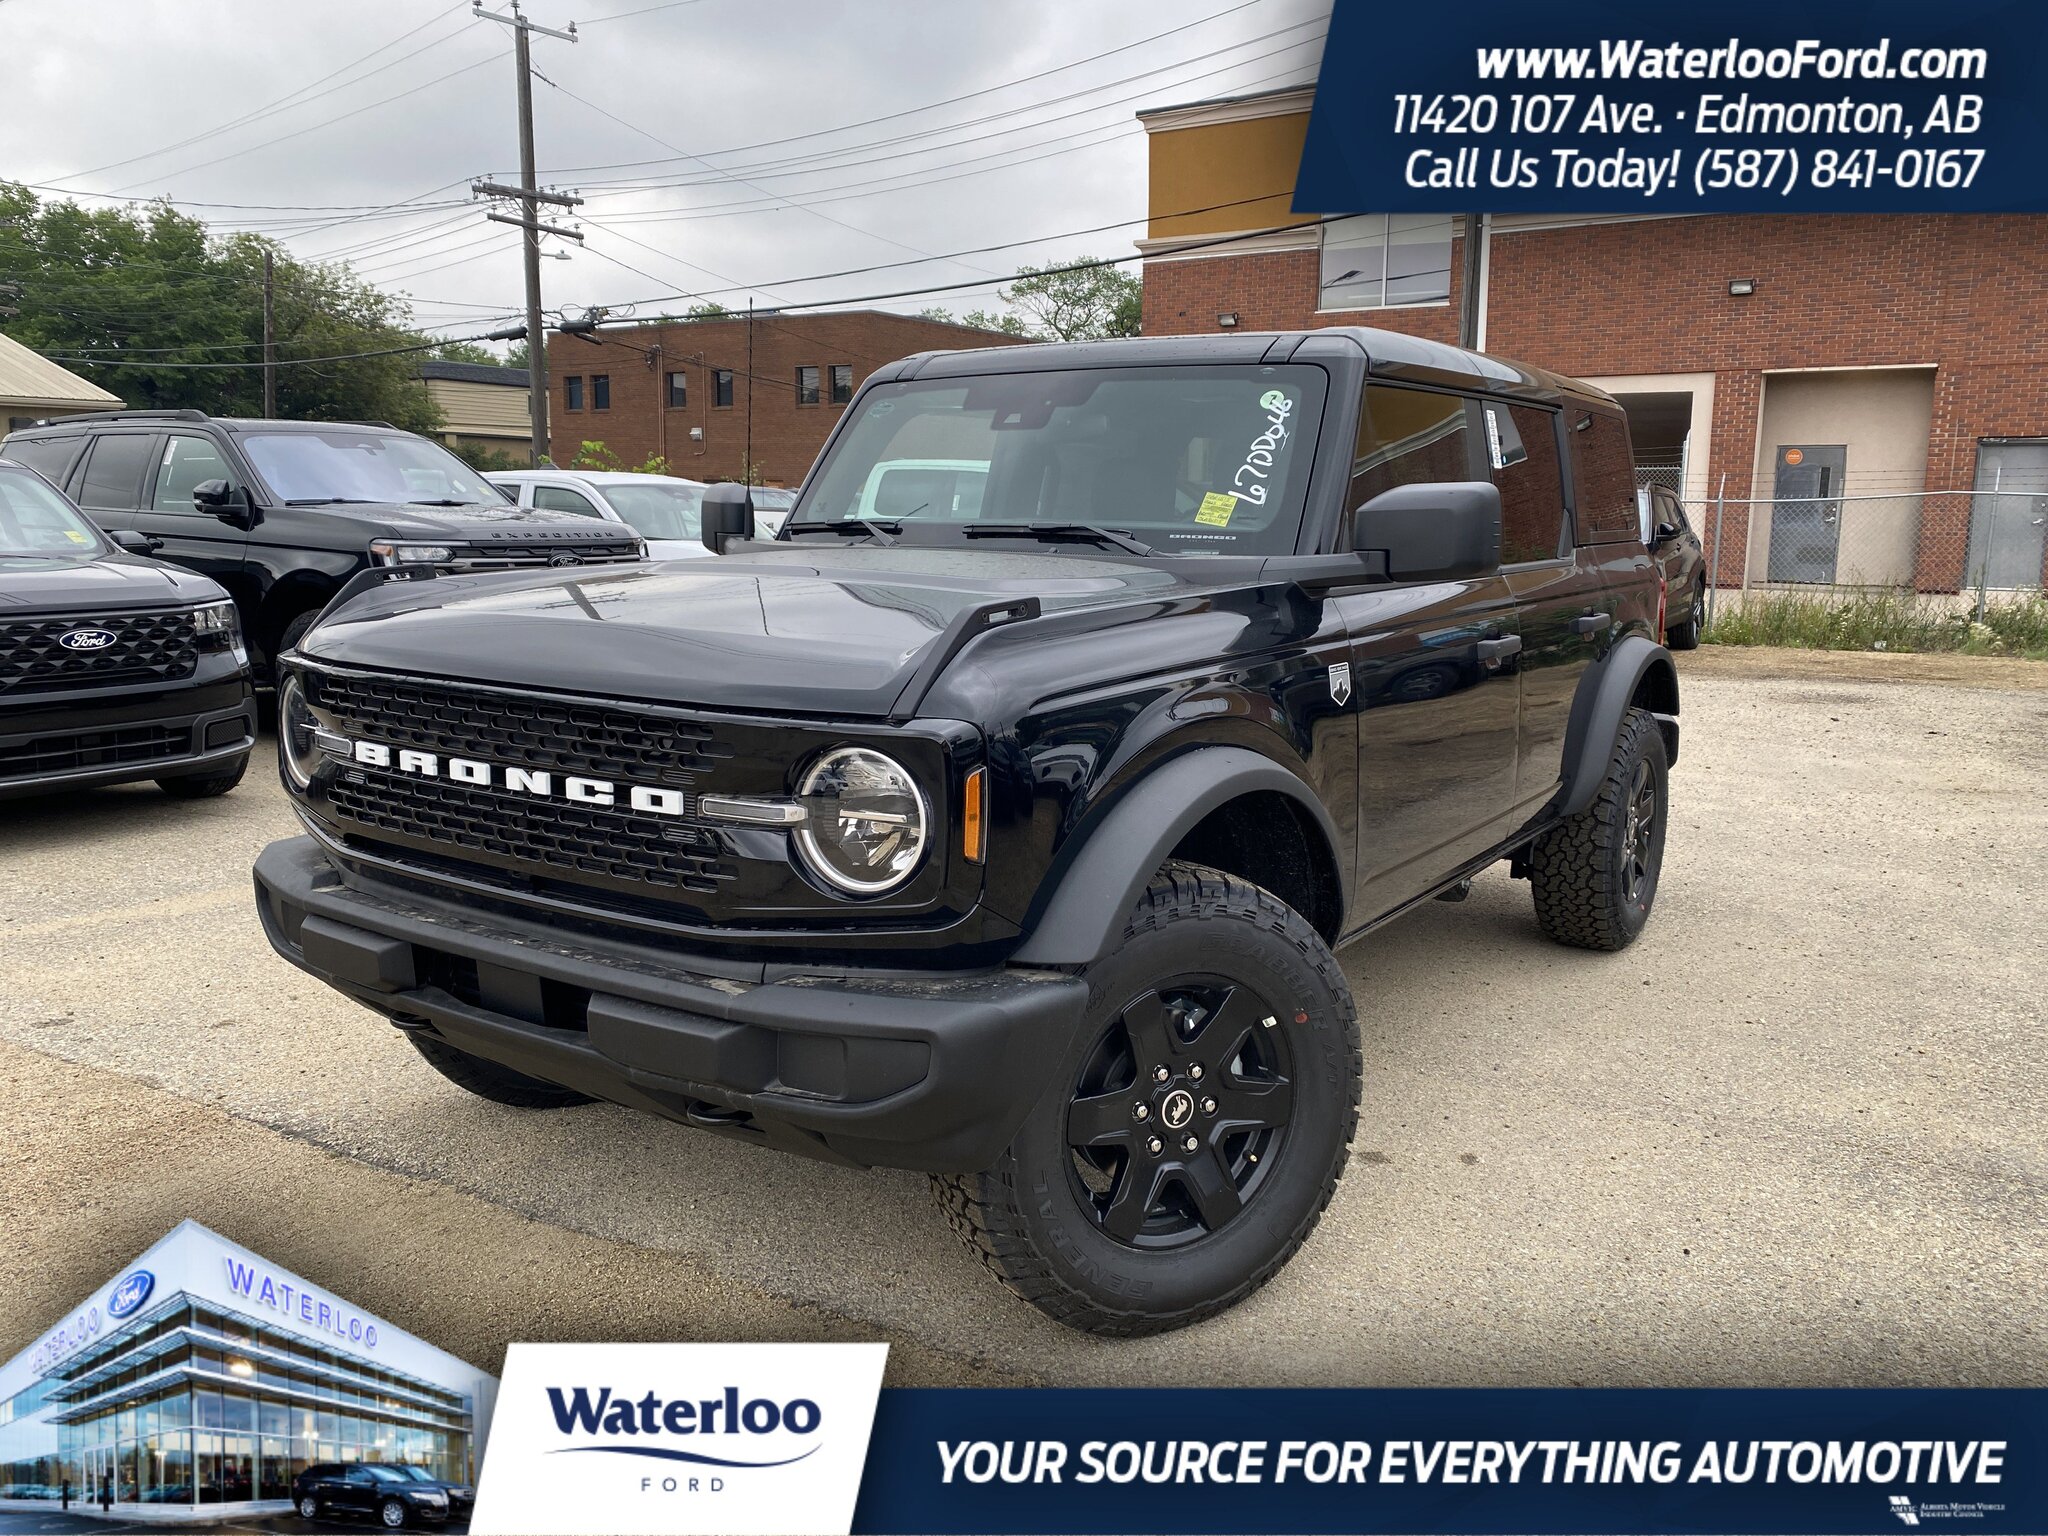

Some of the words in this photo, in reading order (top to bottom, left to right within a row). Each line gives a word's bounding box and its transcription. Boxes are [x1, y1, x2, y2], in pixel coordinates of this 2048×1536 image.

[490, 531, 615, 539] EXPEDITION
[70, 632, 106, 648] Ford
[355, 740, 684, 816] BRONCO
[1032, 1169, 1154, 1300] GENERAL
